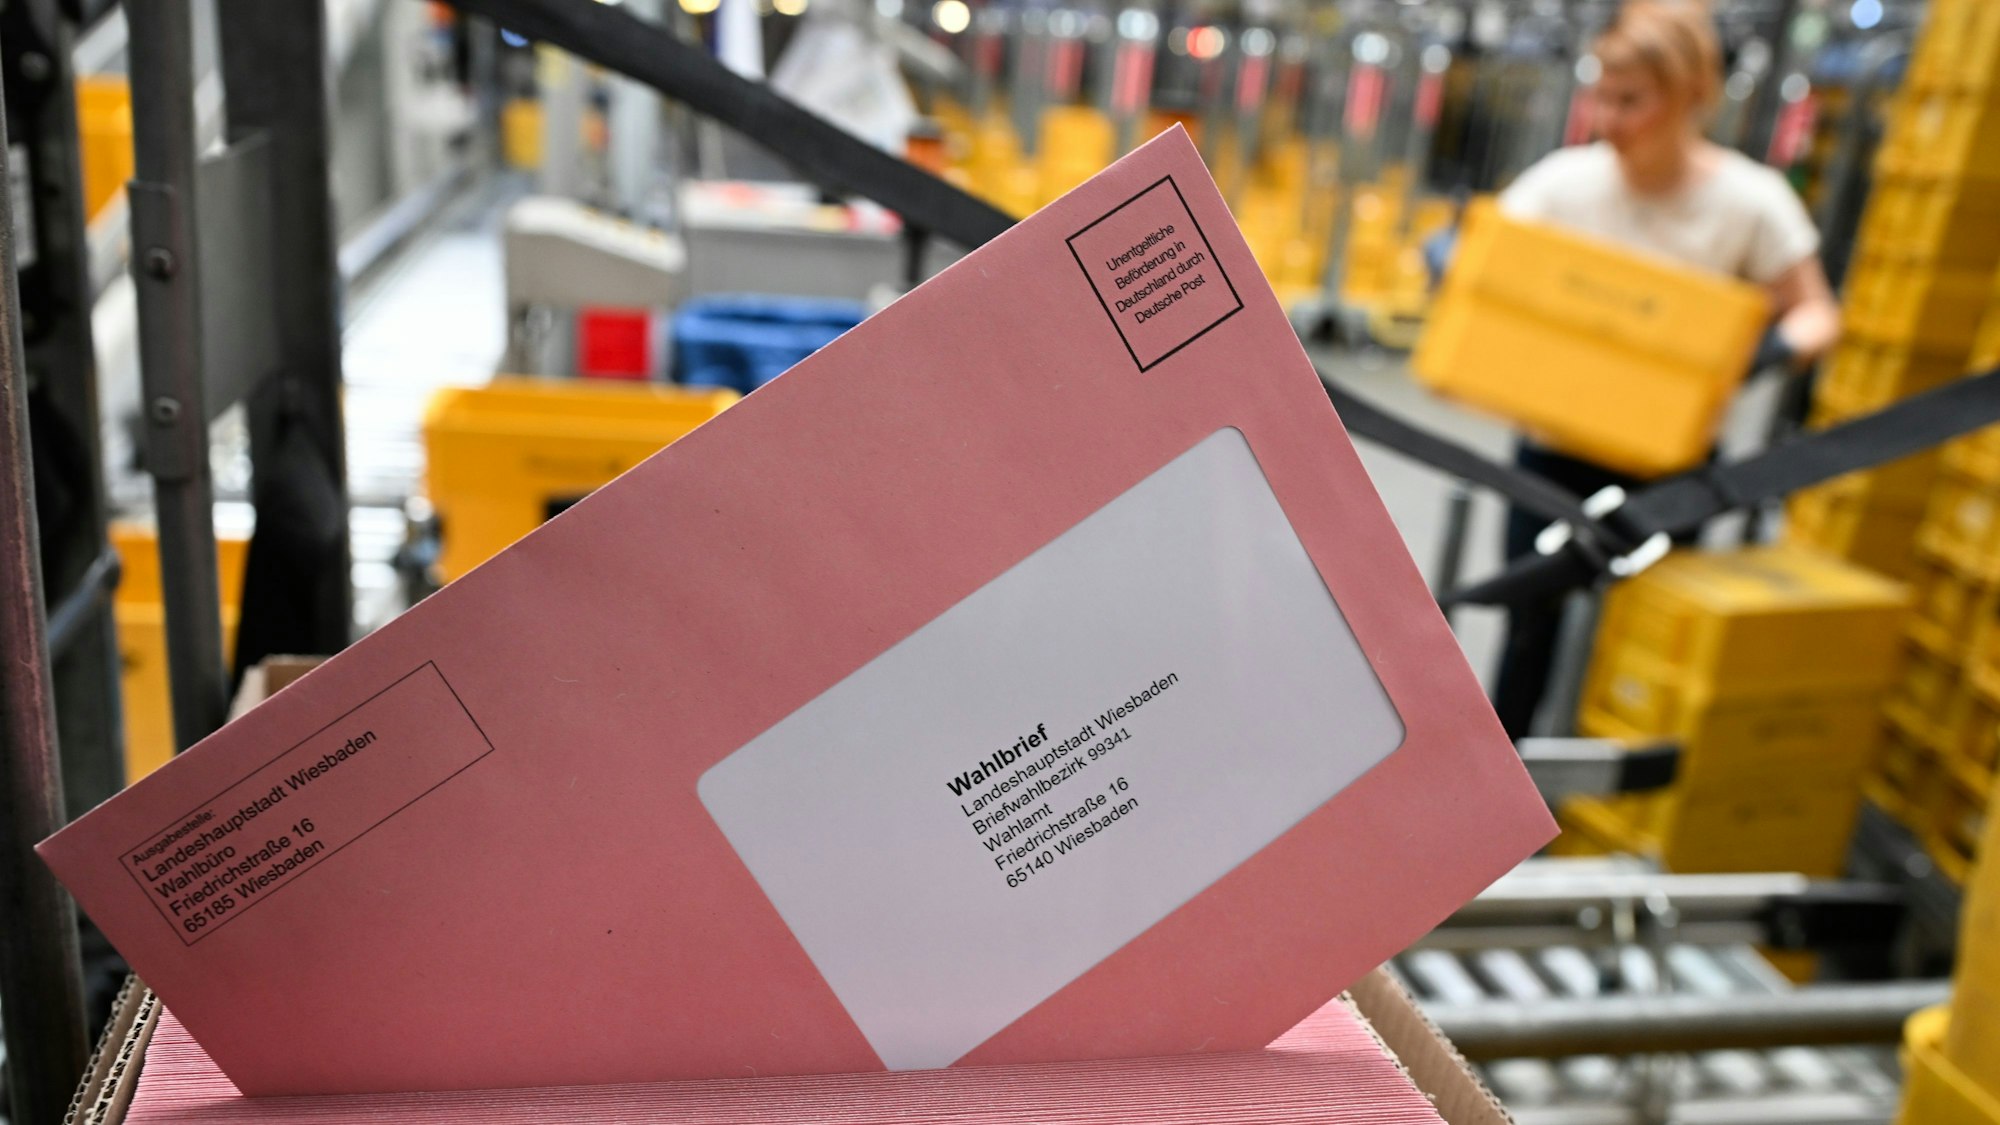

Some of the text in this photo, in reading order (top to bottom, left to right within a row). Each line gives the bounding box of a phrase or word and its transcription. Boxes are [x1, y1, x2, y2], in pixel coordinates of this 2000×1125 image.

[1106, 224, 1174, 271] Unentgeltliche
[1114, 241, 1186, 290] Beförderung in
[1115, 251, 1205, 313] Deutschland durch
[1134, 274, 1206, 324] Deutsche Post
[946, 723, 1049, 796] Wahlbrief
[961, 671, 1179, 817] Landeshauptstadt Wiesbaden
[143, 729, 377, 882] Landeshauptstadt Wiesbaden
[972, 727, 1132, 835] Briefwahlbezirk 99341
[132, 809, 216, 866] Ausgabestelle:
[983, 803, 1053, 852] Wahlamt
[994, 776, 1129, 870] Friedrichstraße 16
[1006, 796, 1139, 888] 65140 Wiesbaden
[155, 844, 235, 899] Wahlbüro
[169, 817, 315, 917] Friedrichstraße 16
[183, 837, 325, 934] 65185 Wiesbaden
